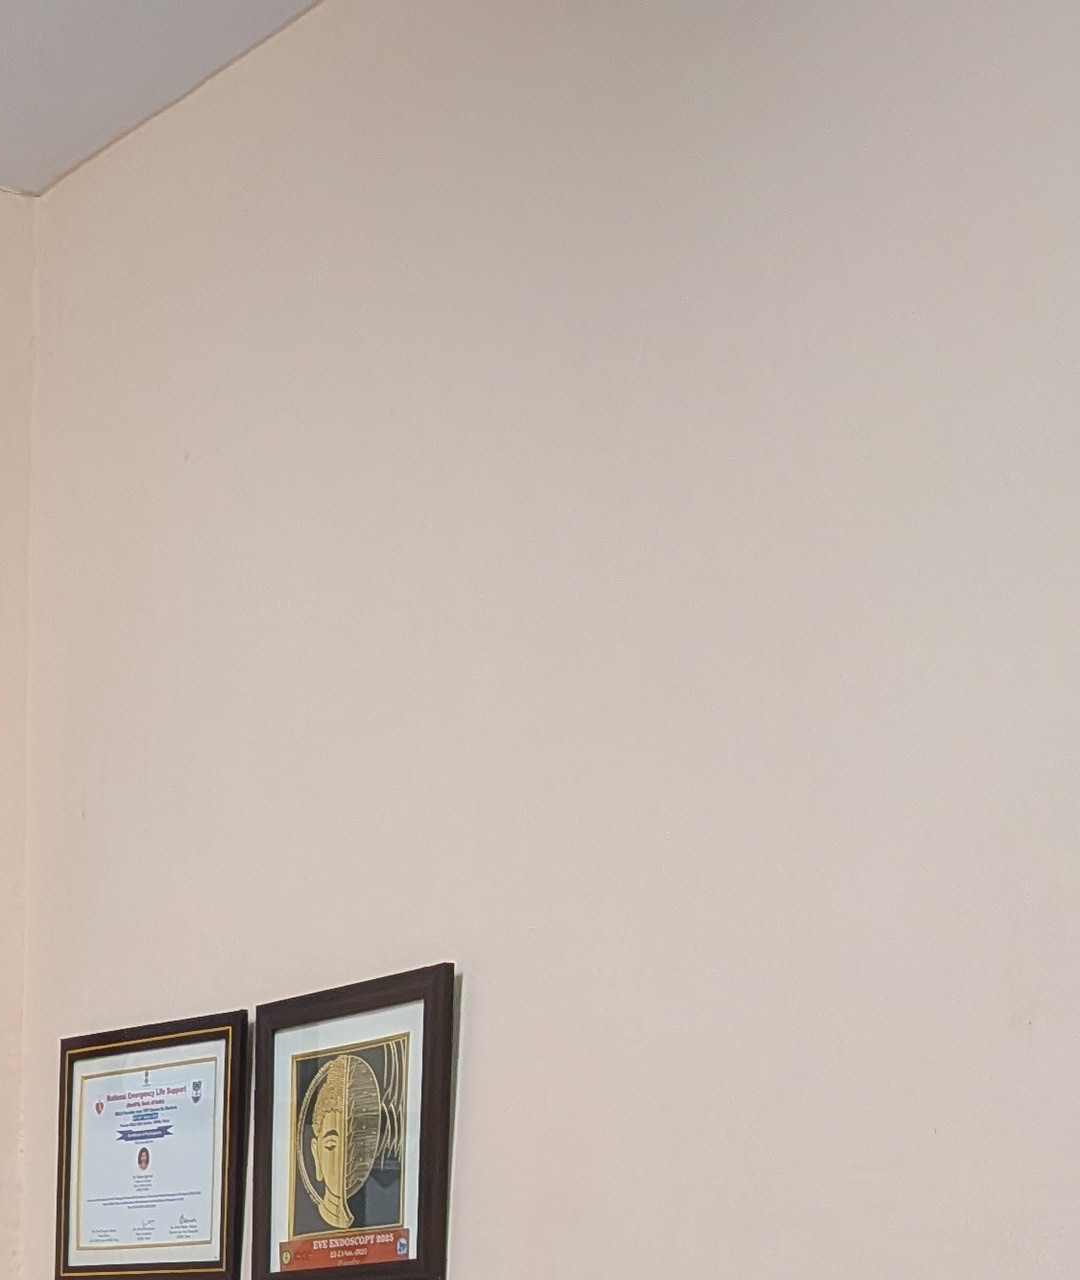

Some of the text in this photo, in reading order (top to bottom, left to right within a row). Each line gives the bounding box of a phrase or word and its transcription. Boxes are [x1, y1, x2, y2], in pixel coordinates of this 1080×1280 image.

[128, 1090, 155, 1100] Emergency
[156, 1088, 166, 1096] Life
[166, 1085, 187, 1095] Support
